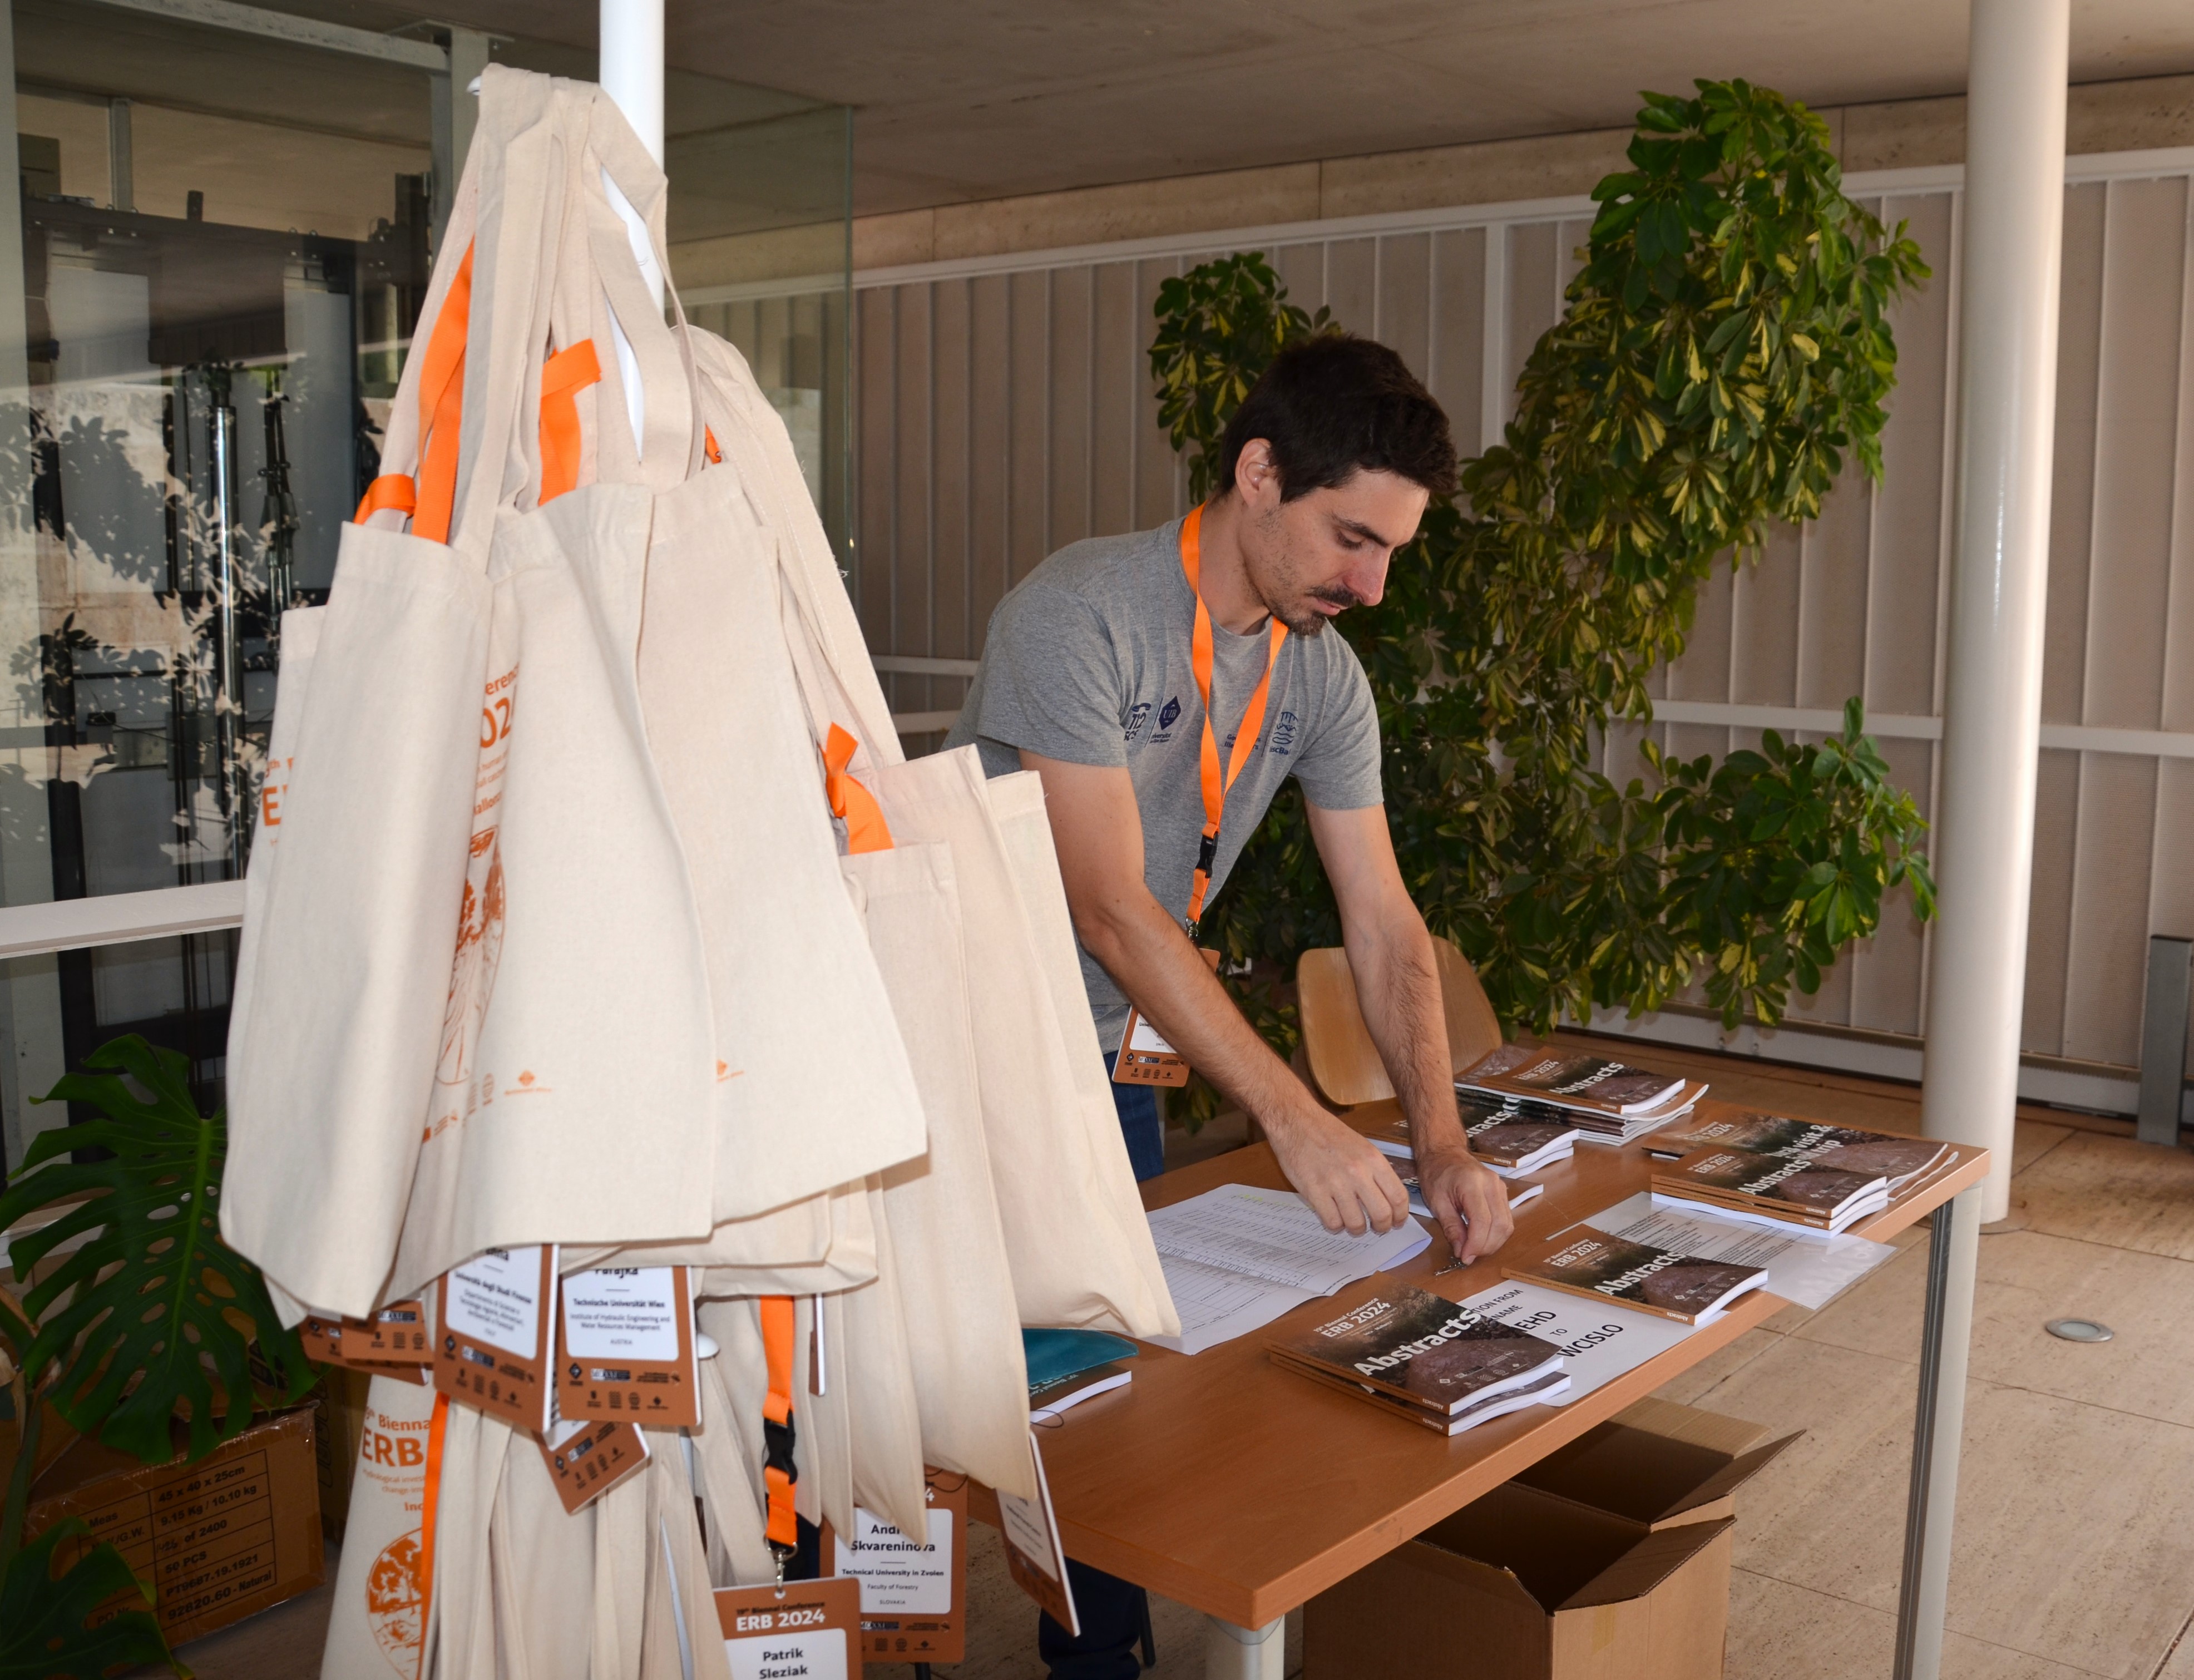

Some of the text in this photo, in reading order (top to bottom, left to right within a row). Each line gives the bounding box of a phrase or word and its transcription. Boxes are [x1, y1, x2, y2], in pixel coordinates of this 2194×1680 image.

[1128, 712, 1147, 729] 112
[1163, 709, 1177, 719] UIB
[1535, 1060, 1560, 1074] 2024
[1548, 1061, 1625, 1094] Abstracts
[1811, 1139, 1845, 1154] trip
[1709, 1154, 1736, 1166] 2024
[1737, 1159, 1812, 1195] Abstracts
[1550, 1254, 1577, 1267] ERB
[1571, 1241, 1602, 1256] 2024
[1594, 1251, 1687, 1296] Abstracts
[1346, 1297, 1380, 1318] Conference
[1493, 1289, 1524, 1303] FROM
[1321, 1321, 1355, 1338] ERB
[1350, 1301, 1391, 1325] 2024
[1353, 1308, 1481, 1377] Abstracts
[1549, 1328, 1568, 1337] TO
[1556, 1323, 1624, 1358] WCISLO
[1422, 1397, 1444, 1410] Abstracts
[1422, 1417, 1444, 1430] Abstracts
[362, 1425, 424, 1467] ERB
[89, 1466, 245, 1528] Meas 45 x 40 x 25cm
[161, 1511, 185, 1526] 9.15
[188, 1504, 204, 1516] Kg
[212, 1490, 241, 1507] 10.10
[243, 1484, 258, 1496] kg
[184, 1530, 197, 1544] of
[199, 1519, 228, 1537] 2400
[165, 1551, 207, 1574] 50 PCS
[168, 1587, 231, 1620] 92820.60
[239, 1570, 272, 1592] Natural
[736, 1608, 826, 1632] ERB 2024
[763, 1647, 803, 1662] Patrik
[759, 1664, 808, 1679] Sleziak
